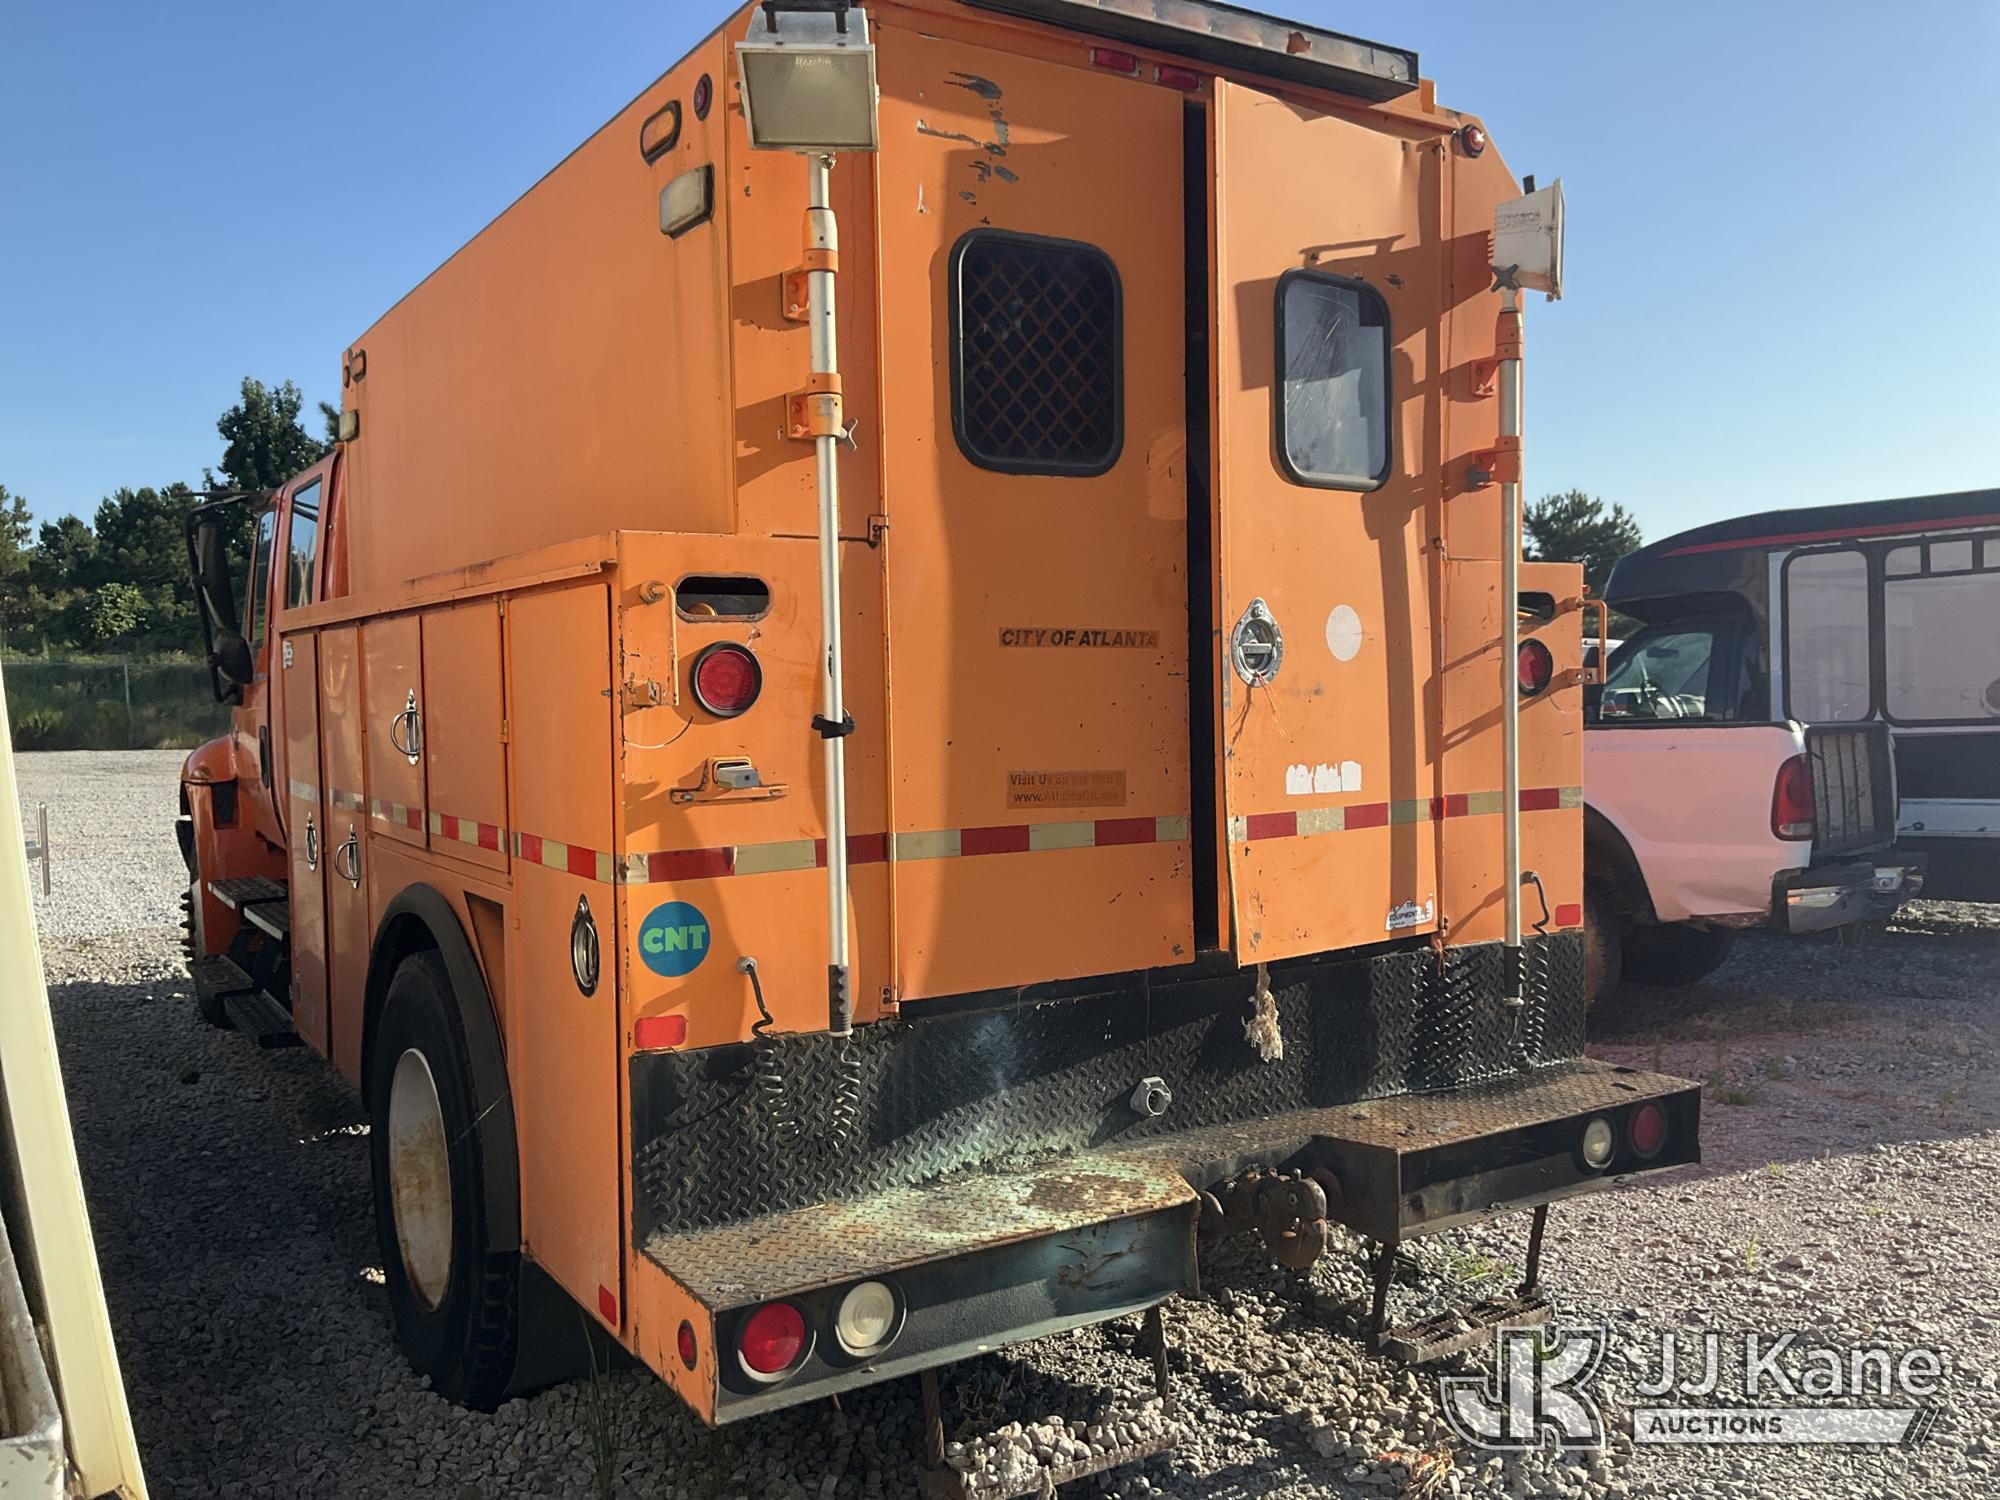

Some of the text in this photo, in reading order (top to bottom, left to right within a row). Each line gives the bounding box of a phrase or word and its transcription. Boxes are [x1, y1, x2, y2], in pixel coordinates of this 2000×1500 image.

[1001, 629, 1159, 649] CITY OF ATLANTA
[1010, 774, 1035, 785] Visit
[643, 924, 706, 954] CNT
